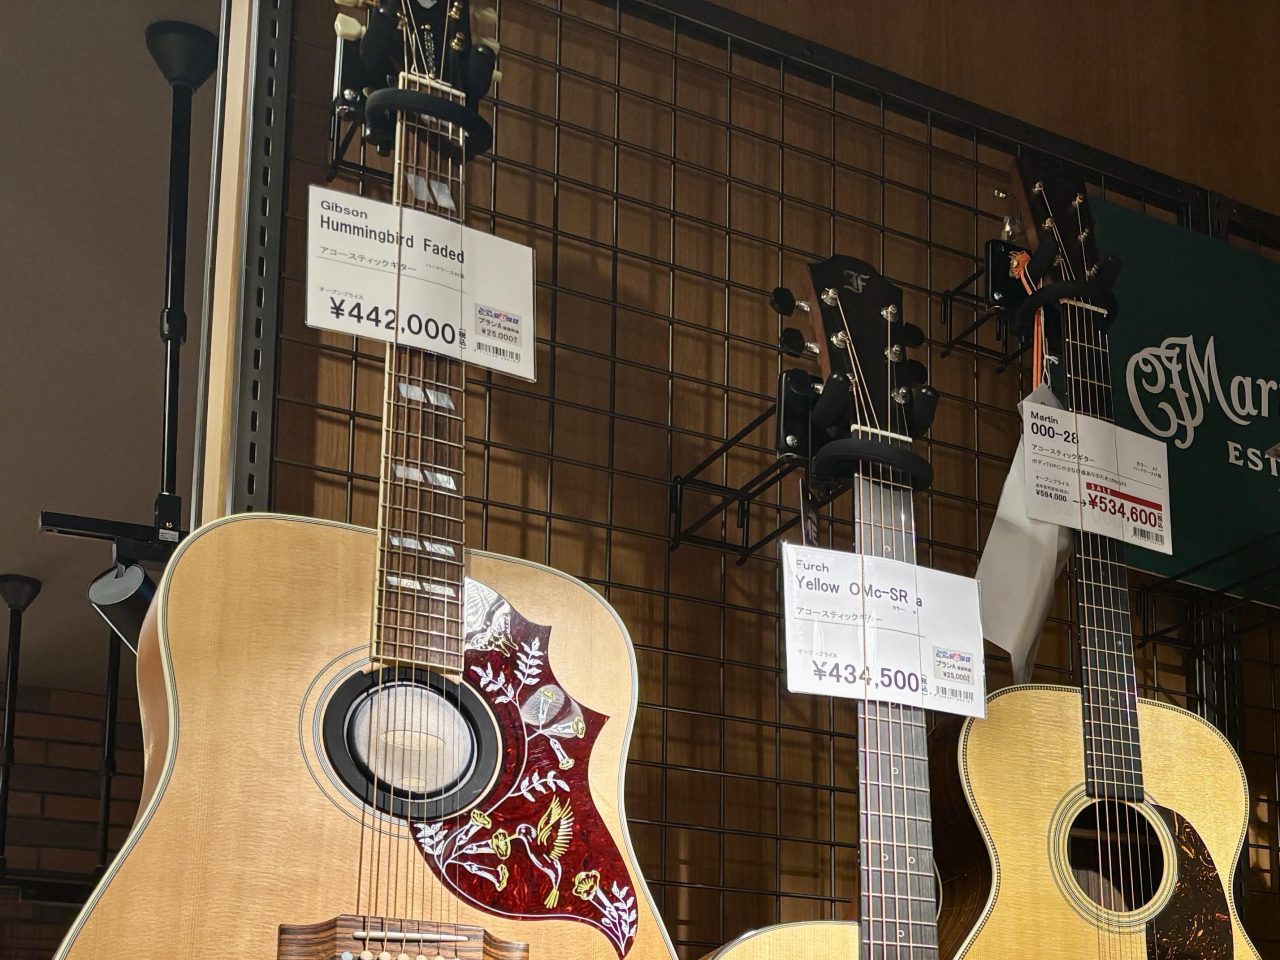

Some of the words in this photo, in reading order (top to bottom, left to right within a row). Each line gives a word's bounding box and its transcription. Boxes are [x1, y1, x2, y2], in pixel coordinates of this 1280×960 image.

[320, 200, 368, 219] Gibson
[320, 215, 414, 248] Hummingbird
[423, 238, 465, 264] Faded
[330, 296, 456, 345] ¥442,000
[1030, 411, 1058, 424] Martin
[1031, 422, 1078, 444] 000-28
[1091, 484, 1112, 495] SALE
[1088, 493, 1156, 528] ¥534,600
[796, 560, 830, 574] Furch
[796, 575, 840, 594] Yellow
[916, 596, 923, 608] a
[812, 660, 920, 693] ¥434,500
